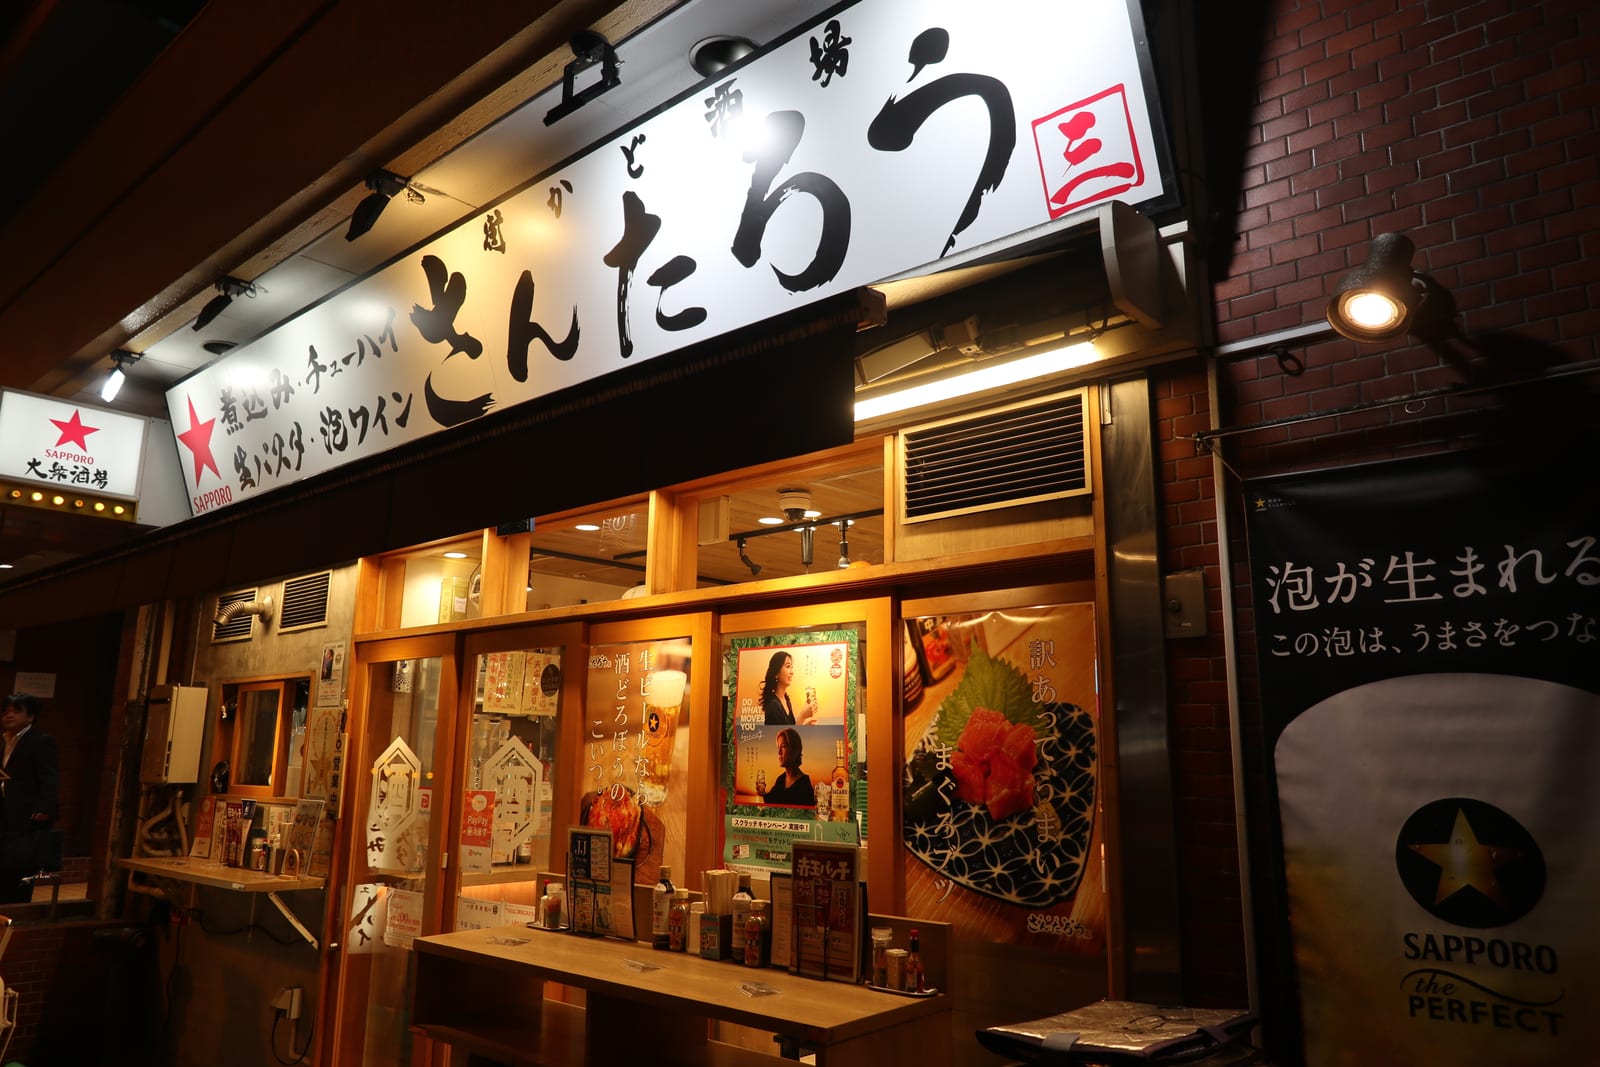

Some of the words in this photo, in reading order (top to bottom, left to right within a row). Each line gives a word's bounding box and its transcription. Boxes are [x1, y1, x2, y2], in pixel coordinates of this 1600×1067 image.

[1050, 111, 1134, 205] 三
[410, 27, 1017, 411] さんたろう
[220, 306, 398, 435] 煮込み・チューハイ
[45, 449, 94, 465] SAPPORO
[234, 392, 412, 491] 生パスタ・泡ワイン
[25, 458, 108, 489] 大衆酒場
[194, 485, 233, 513] SAPPORO
[1266, 536, 1600, 614] 泡が生まれる
[1271, 611, 1597, 657] この泡は、うまさをつな
[740, 714, 765, 722] MOVES
[741, 706, 764, 714] WHAT
[742, 698, 753, 706] DO
[611, 652, 631, 802] 酒どろぼうの
[634, 650, 654, 806] 生ビールなら
[740, 723, 755, 731] YOU
[589, 720, 605, 795] こいつ。
[1029, 640, 1061, 875] 訳あってうまい
[933, 743, 957, 904] まぐろブツ
[1404, 933, 1557, 974] SAPPORO
[1415, 970, 1457, 996] the
[1409, 995, 1566, 1037] PERFECT
